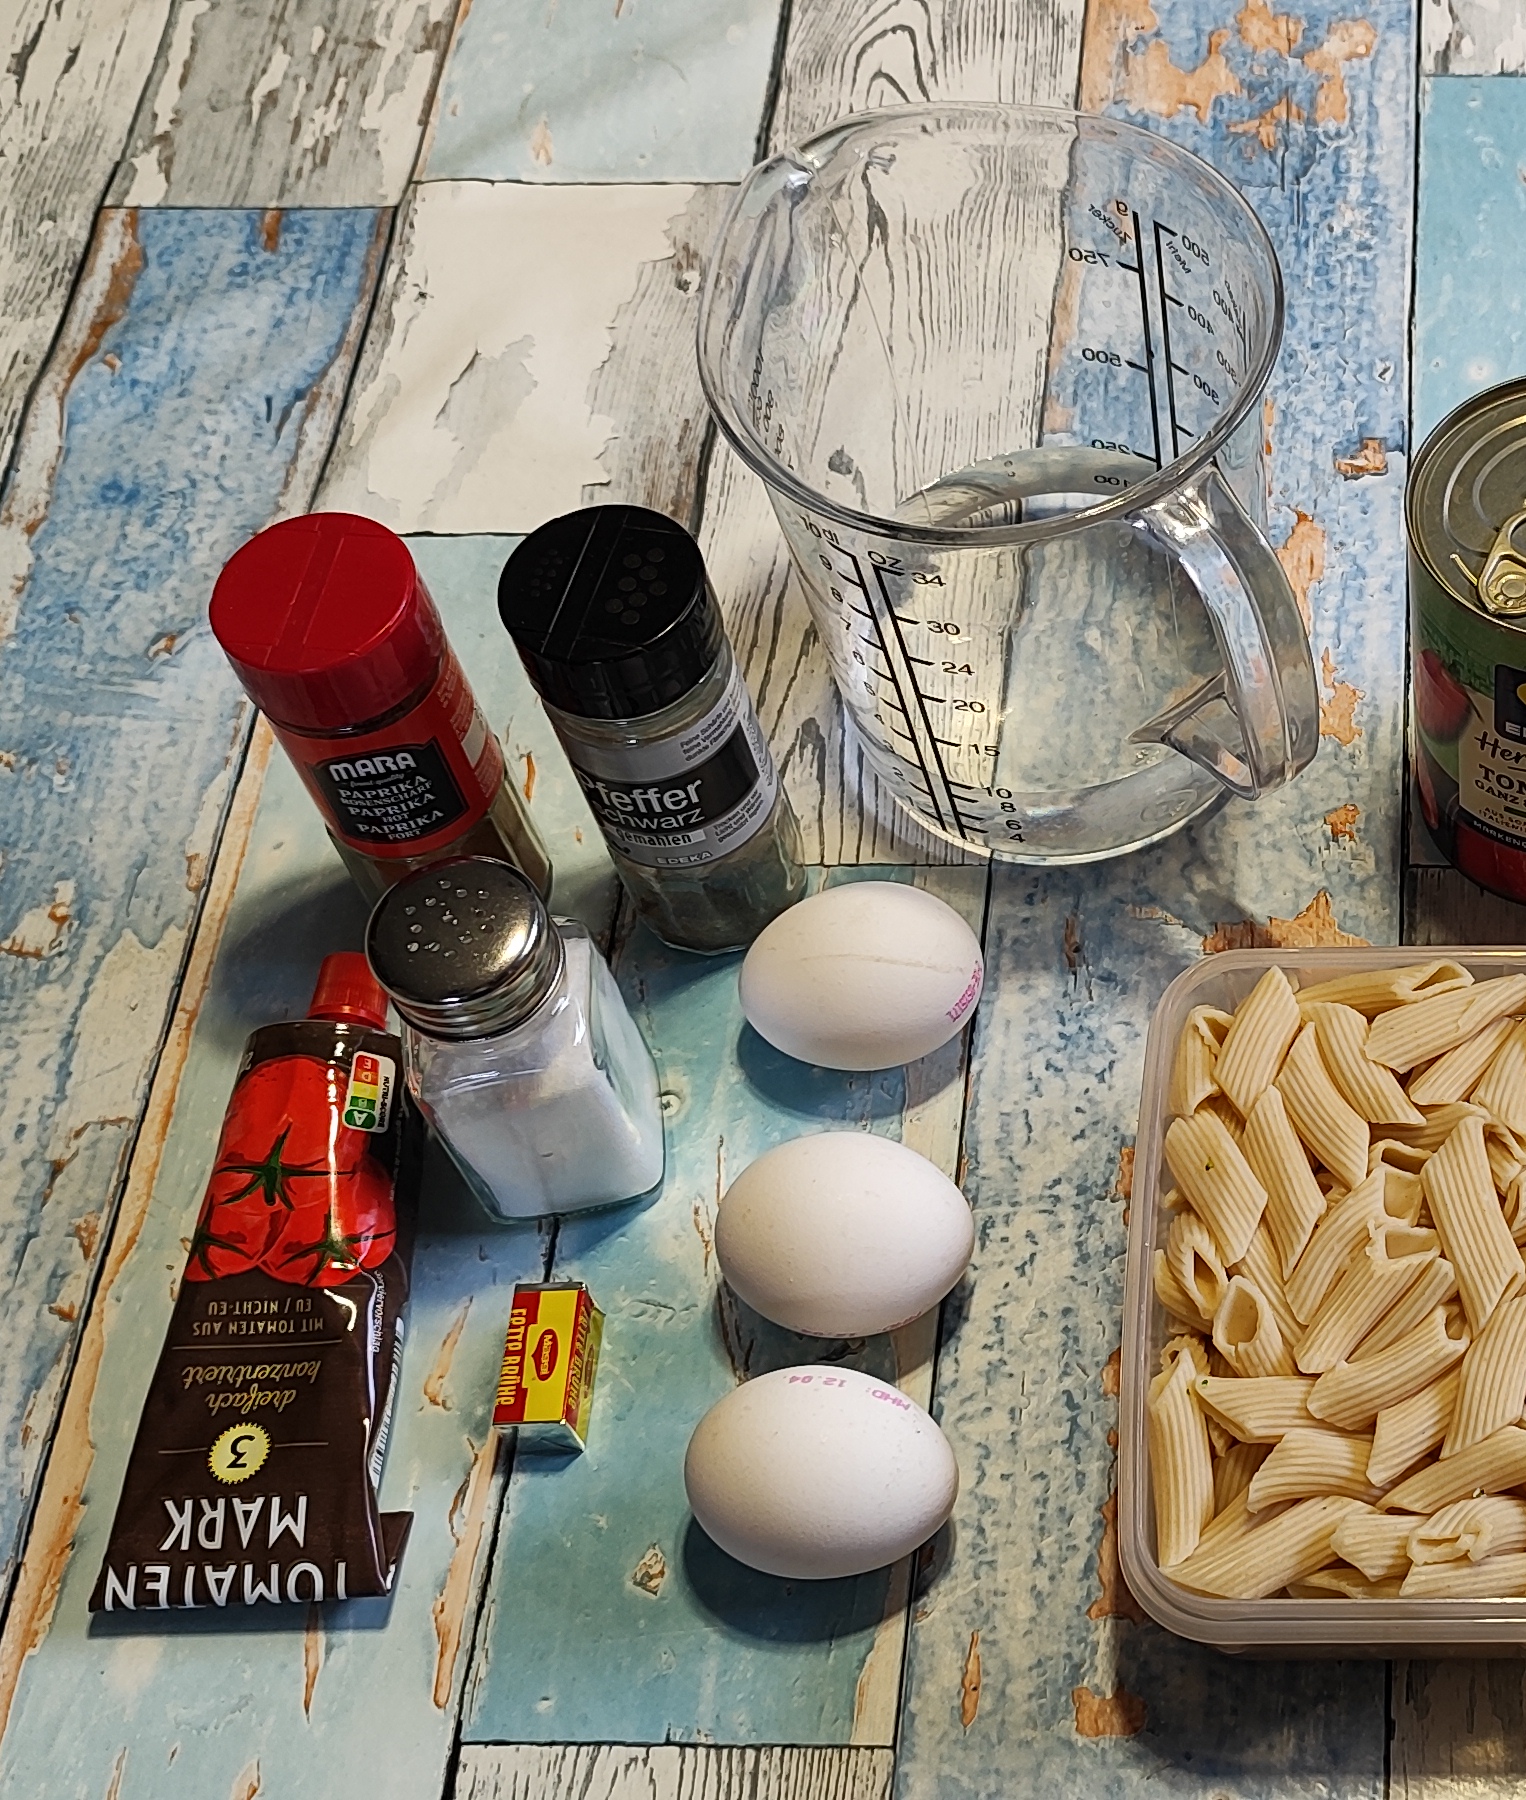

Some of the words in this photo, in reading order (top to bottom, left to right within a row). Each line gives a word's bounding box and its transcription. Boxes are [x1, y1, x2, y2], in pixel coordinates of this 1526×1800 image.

[911, 572, 946, 587] 34
[926, 620, 961, 636] 30
[942, 661, 976, 676] 24
[953, 700, 986, 713] 20
[969, 744, 1001, 757] 15
[329, 752, 417, 782] MARA
[338, 775, 427, 799] PAPRIKA
[982, 786, 1013, 799] 10
[1475, 779, 1520, 805] GANZ
[347, 793, 436, 817] PAPRIKA
[1000, 801, 1017, 813] 8
[356, 810, 444, 834] PAPRIKA
[381, 812, 410, 823] HOT
[1005, 819, 1023, 831] 6
[388, 828, 422, 840] FORT
[616, 828, 692, 847] gemahlen
[1009, 833, 1026, 844] 4
[657, 851, 714, 865] EDEKA
[353, 1110, 369, 1127] A
[208, 1300, 279, 1317] NICHT-EU
[295, 1298, 312, 1312] EU
[192, 1321, 221, 1337] AUS
[228, 1319, 296, 1336] TOMATEN
[300, 1318, 323, 1333] MIT
[182, 1360, 321, 1389] konzentriert
[205, 1389, 297, 1416] dreifach
[226, 1434, 256, 1469] 3
[159, 1495, 308, 1551] MARK
